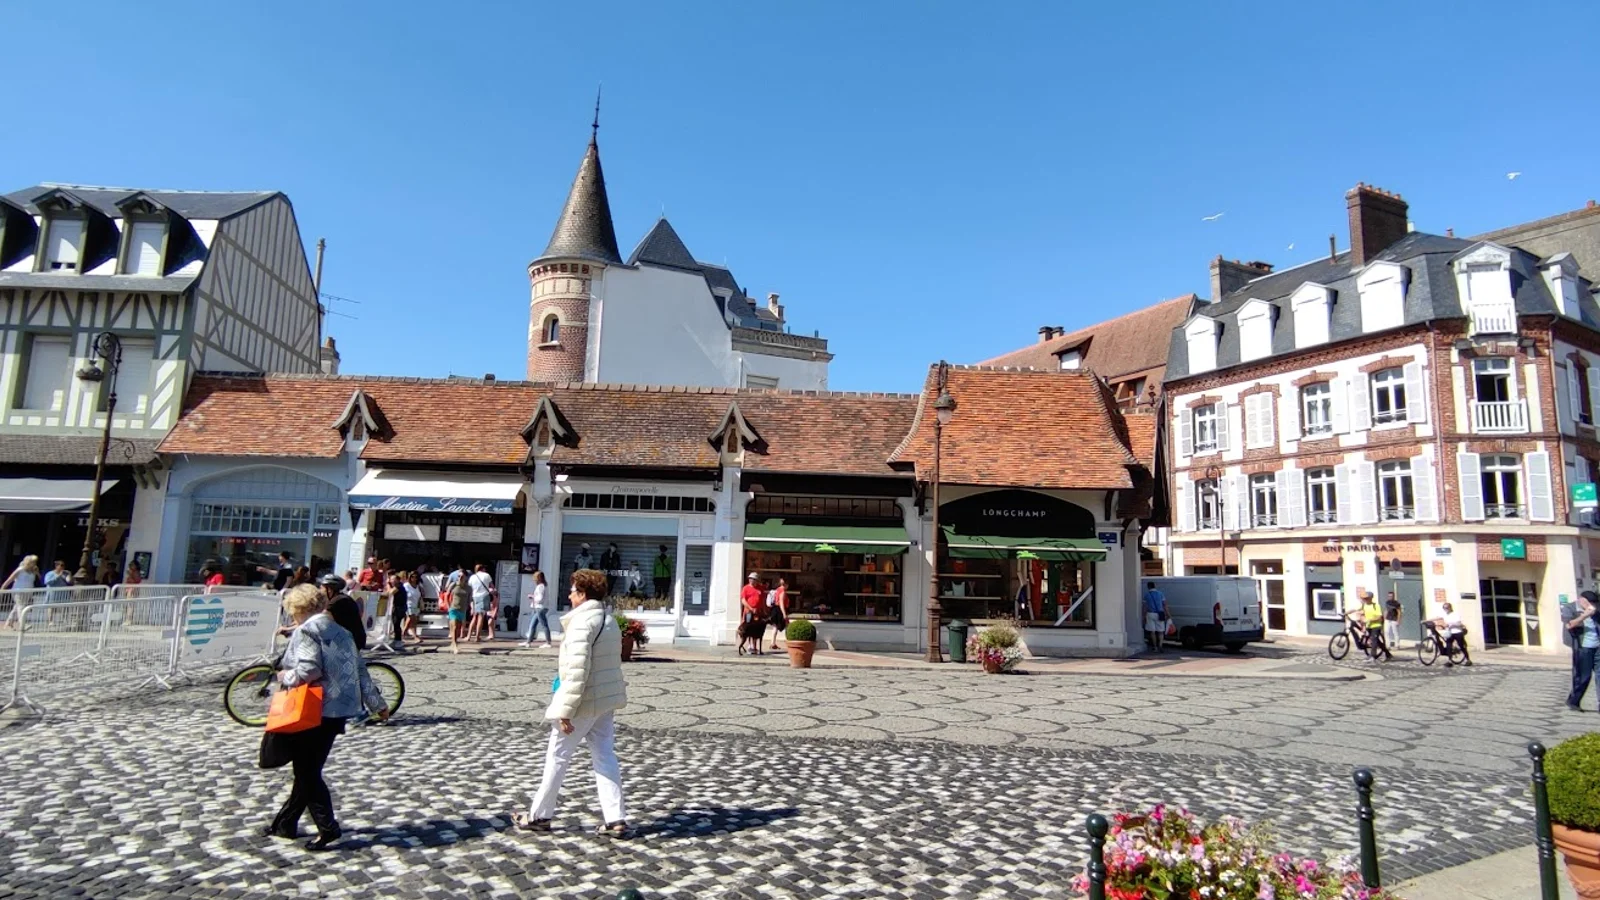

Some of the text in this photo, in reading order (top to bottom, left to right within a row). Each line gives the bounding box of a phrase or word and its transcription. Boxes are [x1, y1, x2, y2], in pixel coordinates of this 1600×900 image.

[432, 497, 493, 513] Lambert
[982, 508, 1046, 517] LONGCHAMP
[1322, 543, 1395, 553] BNP PARIBAS
[225, 610, 249, 619] entrez
[250, 610, 260, 618] en
[224, 619, 258, 630] piétonne
